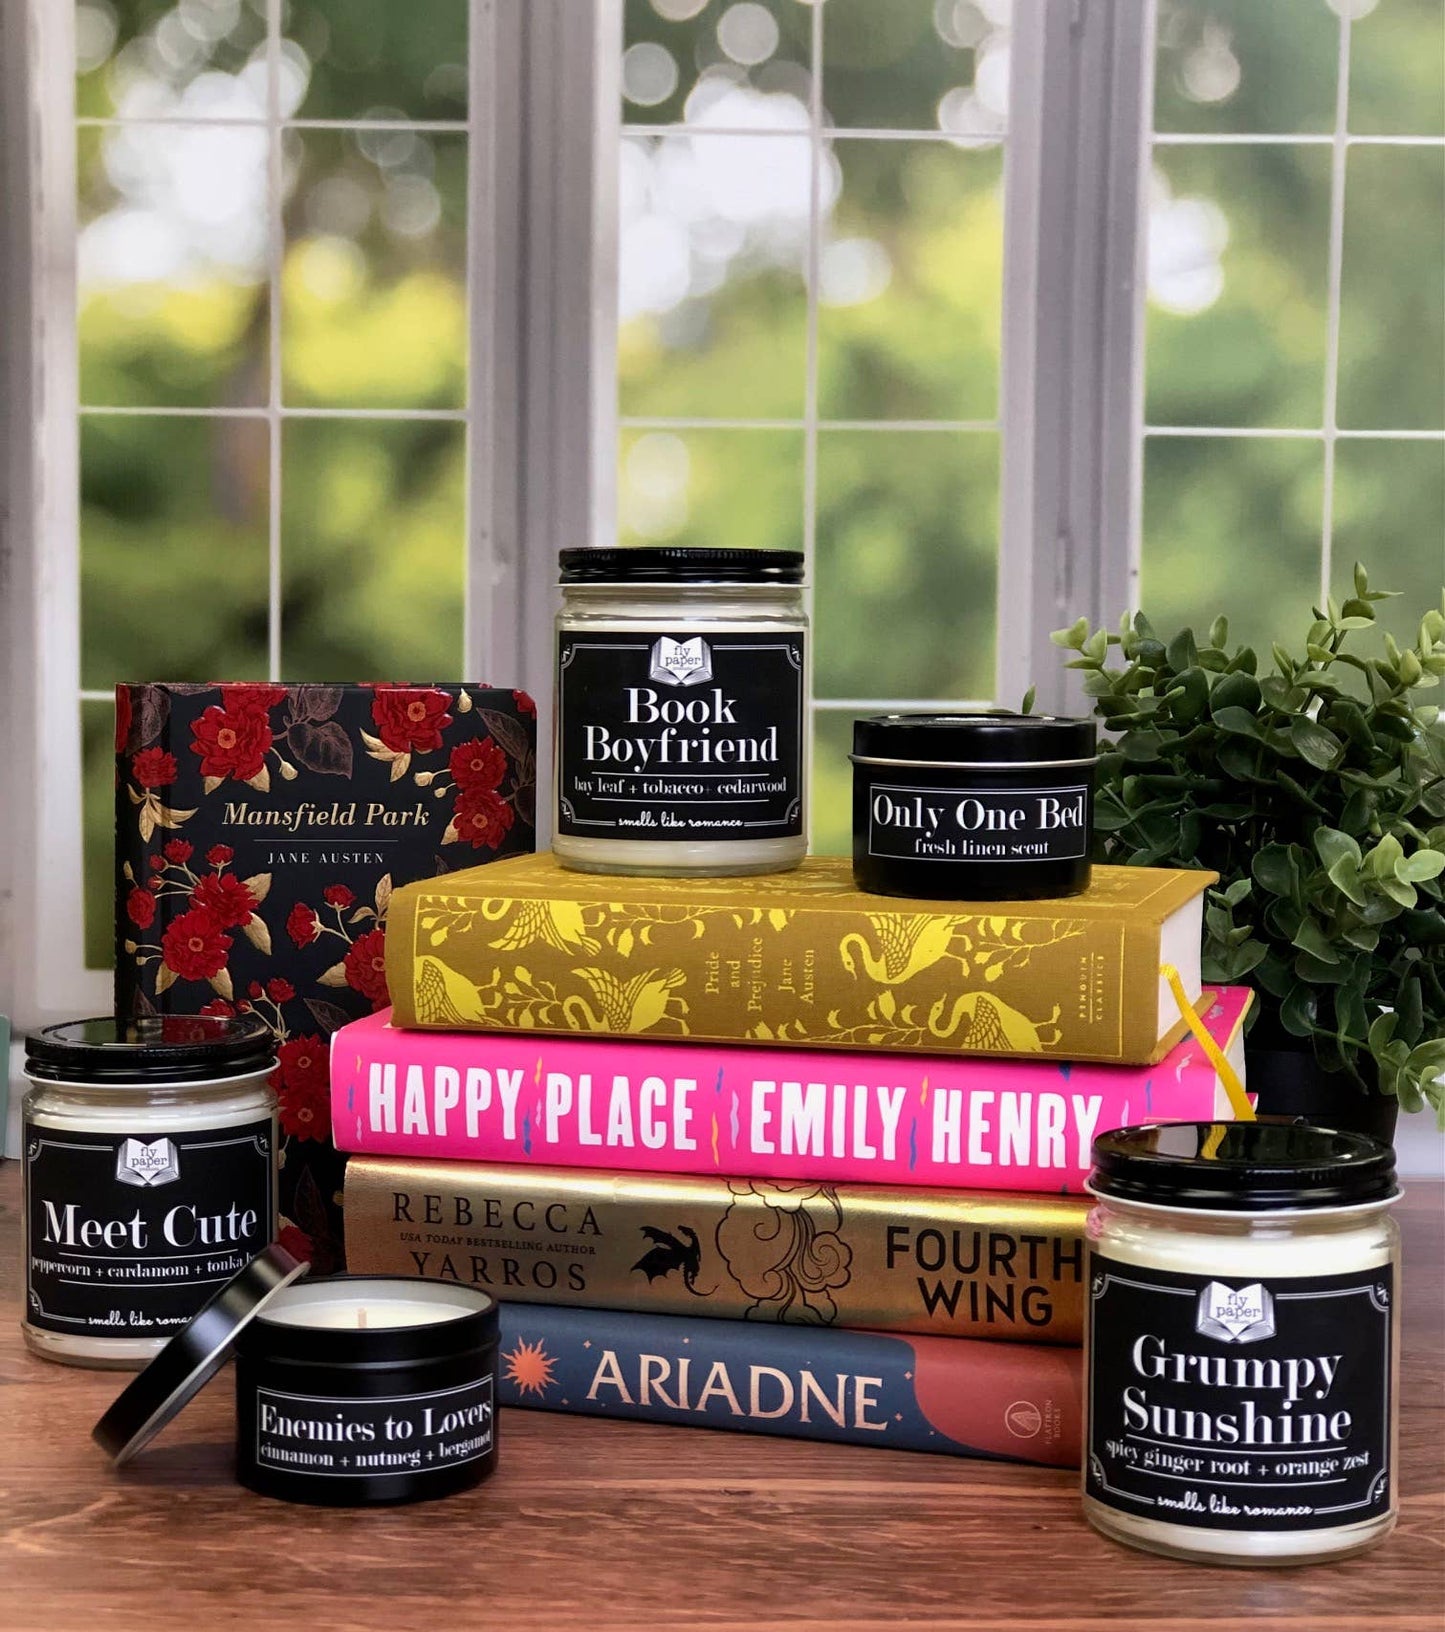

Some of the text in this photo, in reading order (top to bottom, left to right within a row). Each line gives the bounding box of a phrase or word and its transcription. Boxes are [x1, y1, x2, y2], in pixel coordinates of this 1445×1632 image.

[665, 656, 701, 667] paper
[674, 645, 691, 659] fly
[623, 687, 739, 724] Book
[583, 725, 780, 773] Boyfriend
[574, 776, 594, 796] bay
[598, 777, 626, 794] leaf
[643, 779, 704, 795] tobacco
[717, 777, 787, 795] cedarwood
[221, 802, 430, 832] Mansfield Park
[618, 811, 743, 828] smells like romance
[873, 794, 1084, 838] Only One Bed
[267, 852, 384, 865] JANE AUSTEN
[915, 838, 1049, 856] fresh linen scent
[705, 951, 720, 994] Pride
[726, 960, 741, 988] and
[747, 937, 767, 1012] Prejudice
[778, 958, 796, 994] Jane
[800, 949, 815, 1005] Austen
[368, 1062, 1104, 1170] HAPPY PLACE EMILY HENRY
[131, 1157, 168, 1168] paper
[140, 1146, 157, 1160] fly
[42, 1200, 257, 1249] Meet Cute
[392, 1192, 603, 1236] REBECCA
[400, 1232, 597, 1255] USA TODAY BESTSELLING AUTHOR
[886, 1226, 1083, 1283] FOURTH
[32, 1256, 91, 1277] peppercorn
[107, 1263, 189, 1277] cardamom
[207, 1255, 243, 1273] tonka
[410, 1251, 586, 1291] YARROS
[88, 1310, 127, 1326] smells
[129, 1310, 154, 1326] like
[917, 1277, 1054, 1327] WING
[1216, 1306, 1261, 1319] paper
[1227, 1293, 1248, 1309] fly
[1132, 1334, 1344, 1401] Grumpy
[586, 1350, 888, 1431] ARIADNE
[261, 1401, 493, 1442] Enemies to Lovers
[1122, 1386, 1352, 1445] Sunshine
[260, 1442, 334, 1467] cinnamon
[355, 1449, 420, 1467] nutmeg
[438, 1430, 491, 1458] bergamot
[1105, 1439, 1139, 1464] spicy
[1144, 1447, 1204, 1474] ginger
[1210, 1458, 1251, 1475] root
[1275, 1457, 1339, 1477] orange
[1343, 1450, 1370, 1471] zest
[1157, 1491, 1313, 1516] smells like romance
